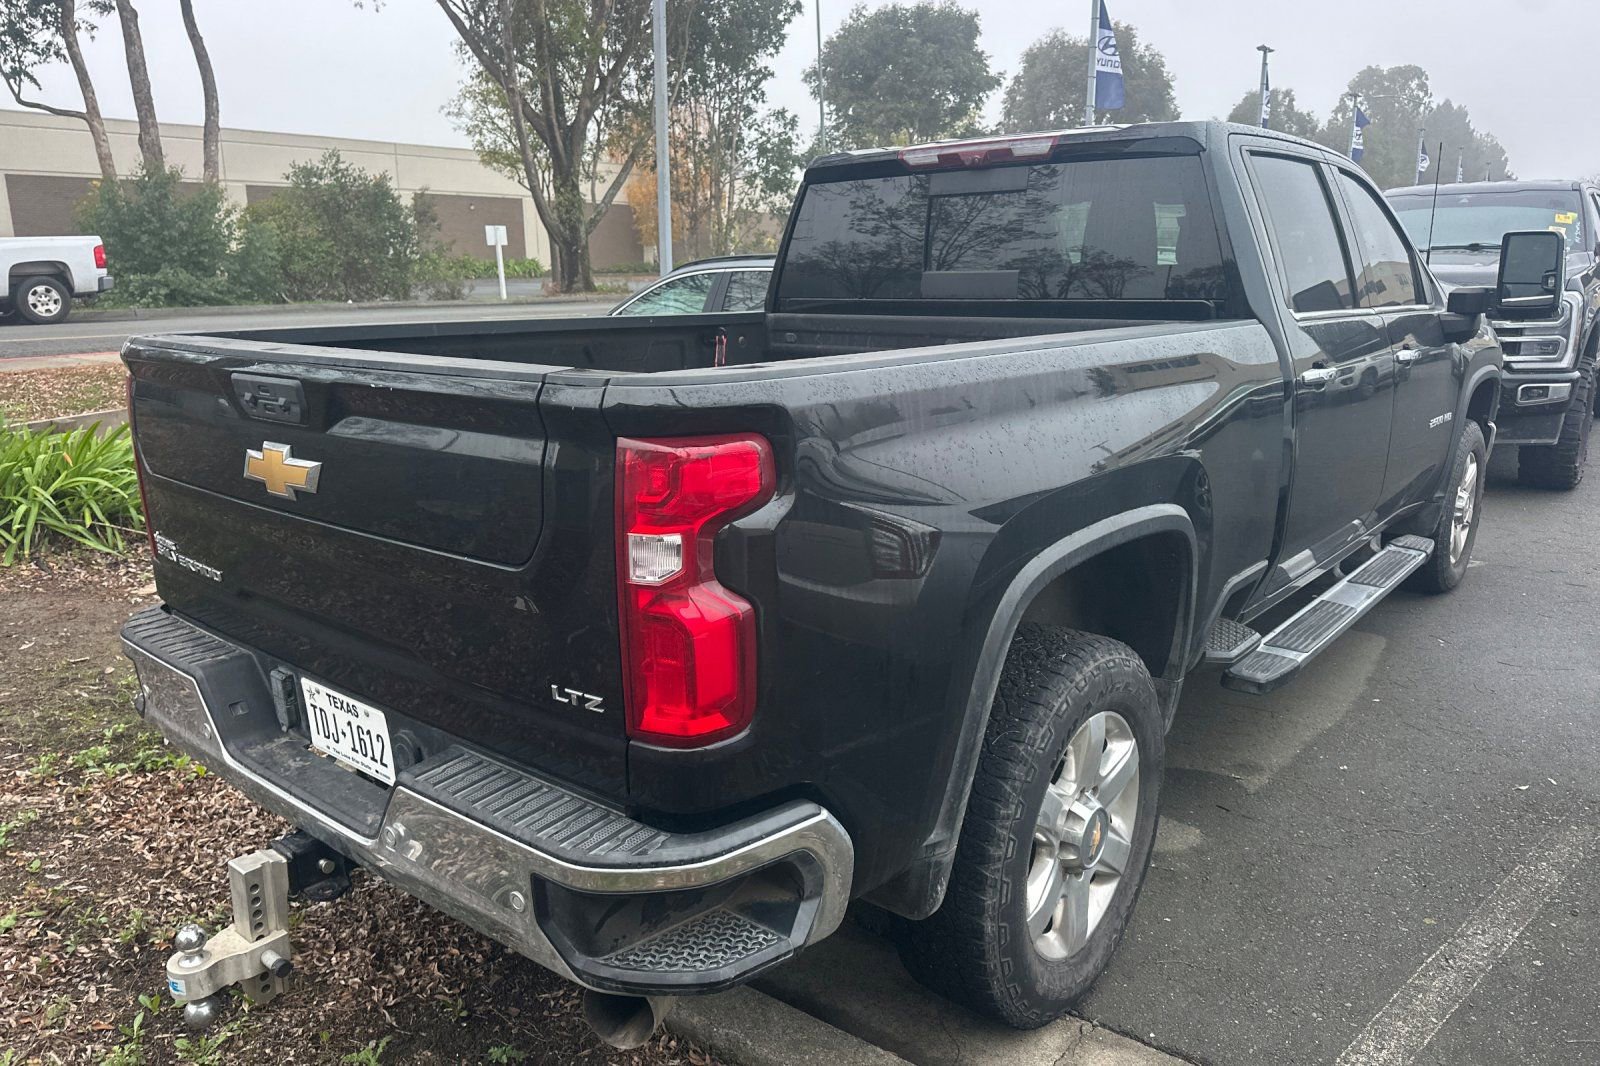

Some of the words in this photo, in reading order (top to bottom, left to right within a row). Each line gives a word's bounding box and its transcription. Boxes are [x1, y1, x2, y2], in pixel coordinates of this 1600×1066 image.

[1096, 57, 1120, 69] YUND
[326, 692, 359, 718] TEXAS
[551, 684, 604, 713] LTZ
